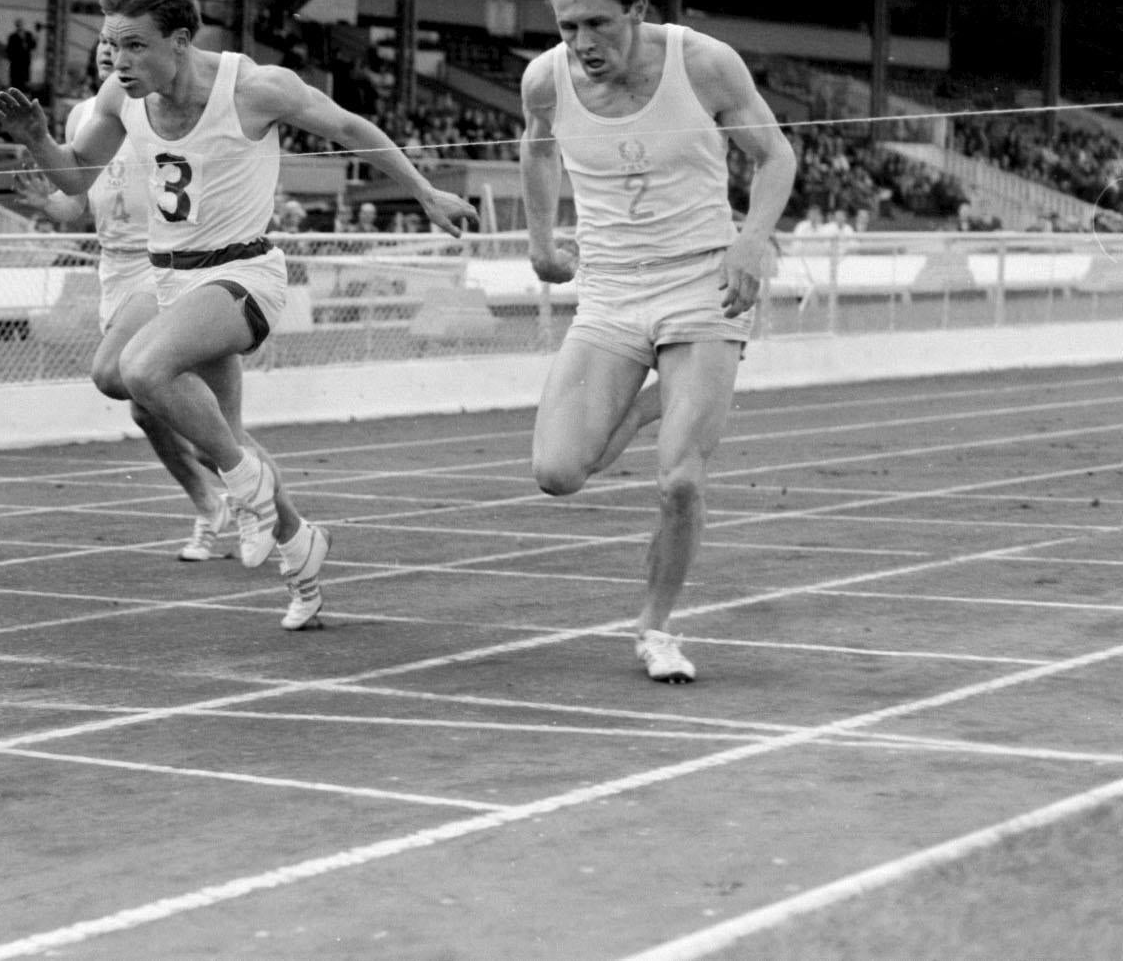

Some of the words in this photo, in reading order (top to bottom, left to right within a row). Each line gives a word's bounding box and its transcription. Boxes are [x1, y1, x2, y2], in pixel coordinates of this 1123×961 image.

[113, 192, 131, 223] 4
[155, 152, 192, 222] 3
[625, 172, 654, 220] 2
